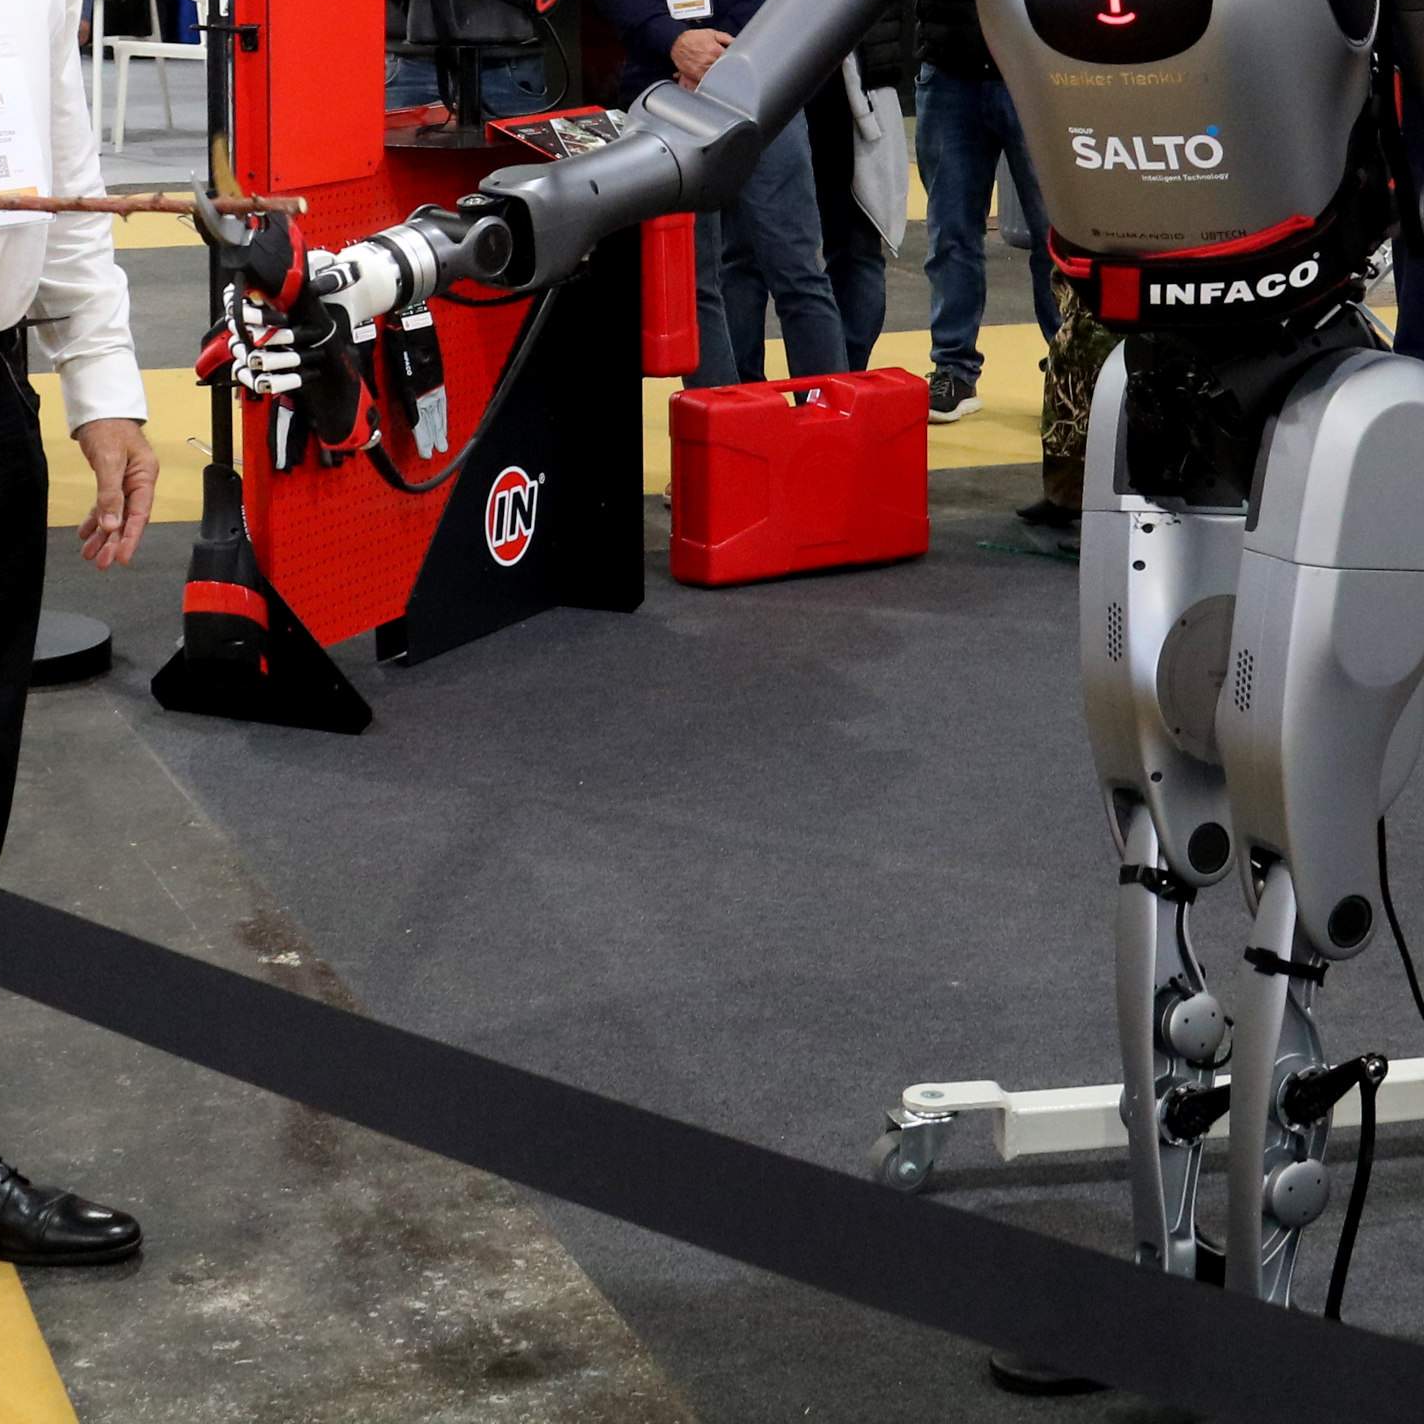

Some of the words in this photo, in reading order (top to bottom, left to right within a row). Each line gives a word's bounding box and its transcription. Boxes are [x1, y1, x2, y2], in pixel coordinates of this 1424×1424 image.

[1072, 134, 1224, 171] SALTO
[1183, 172, 1229, 183] Technology
[1149, 259, 1320, 306] INFACO
